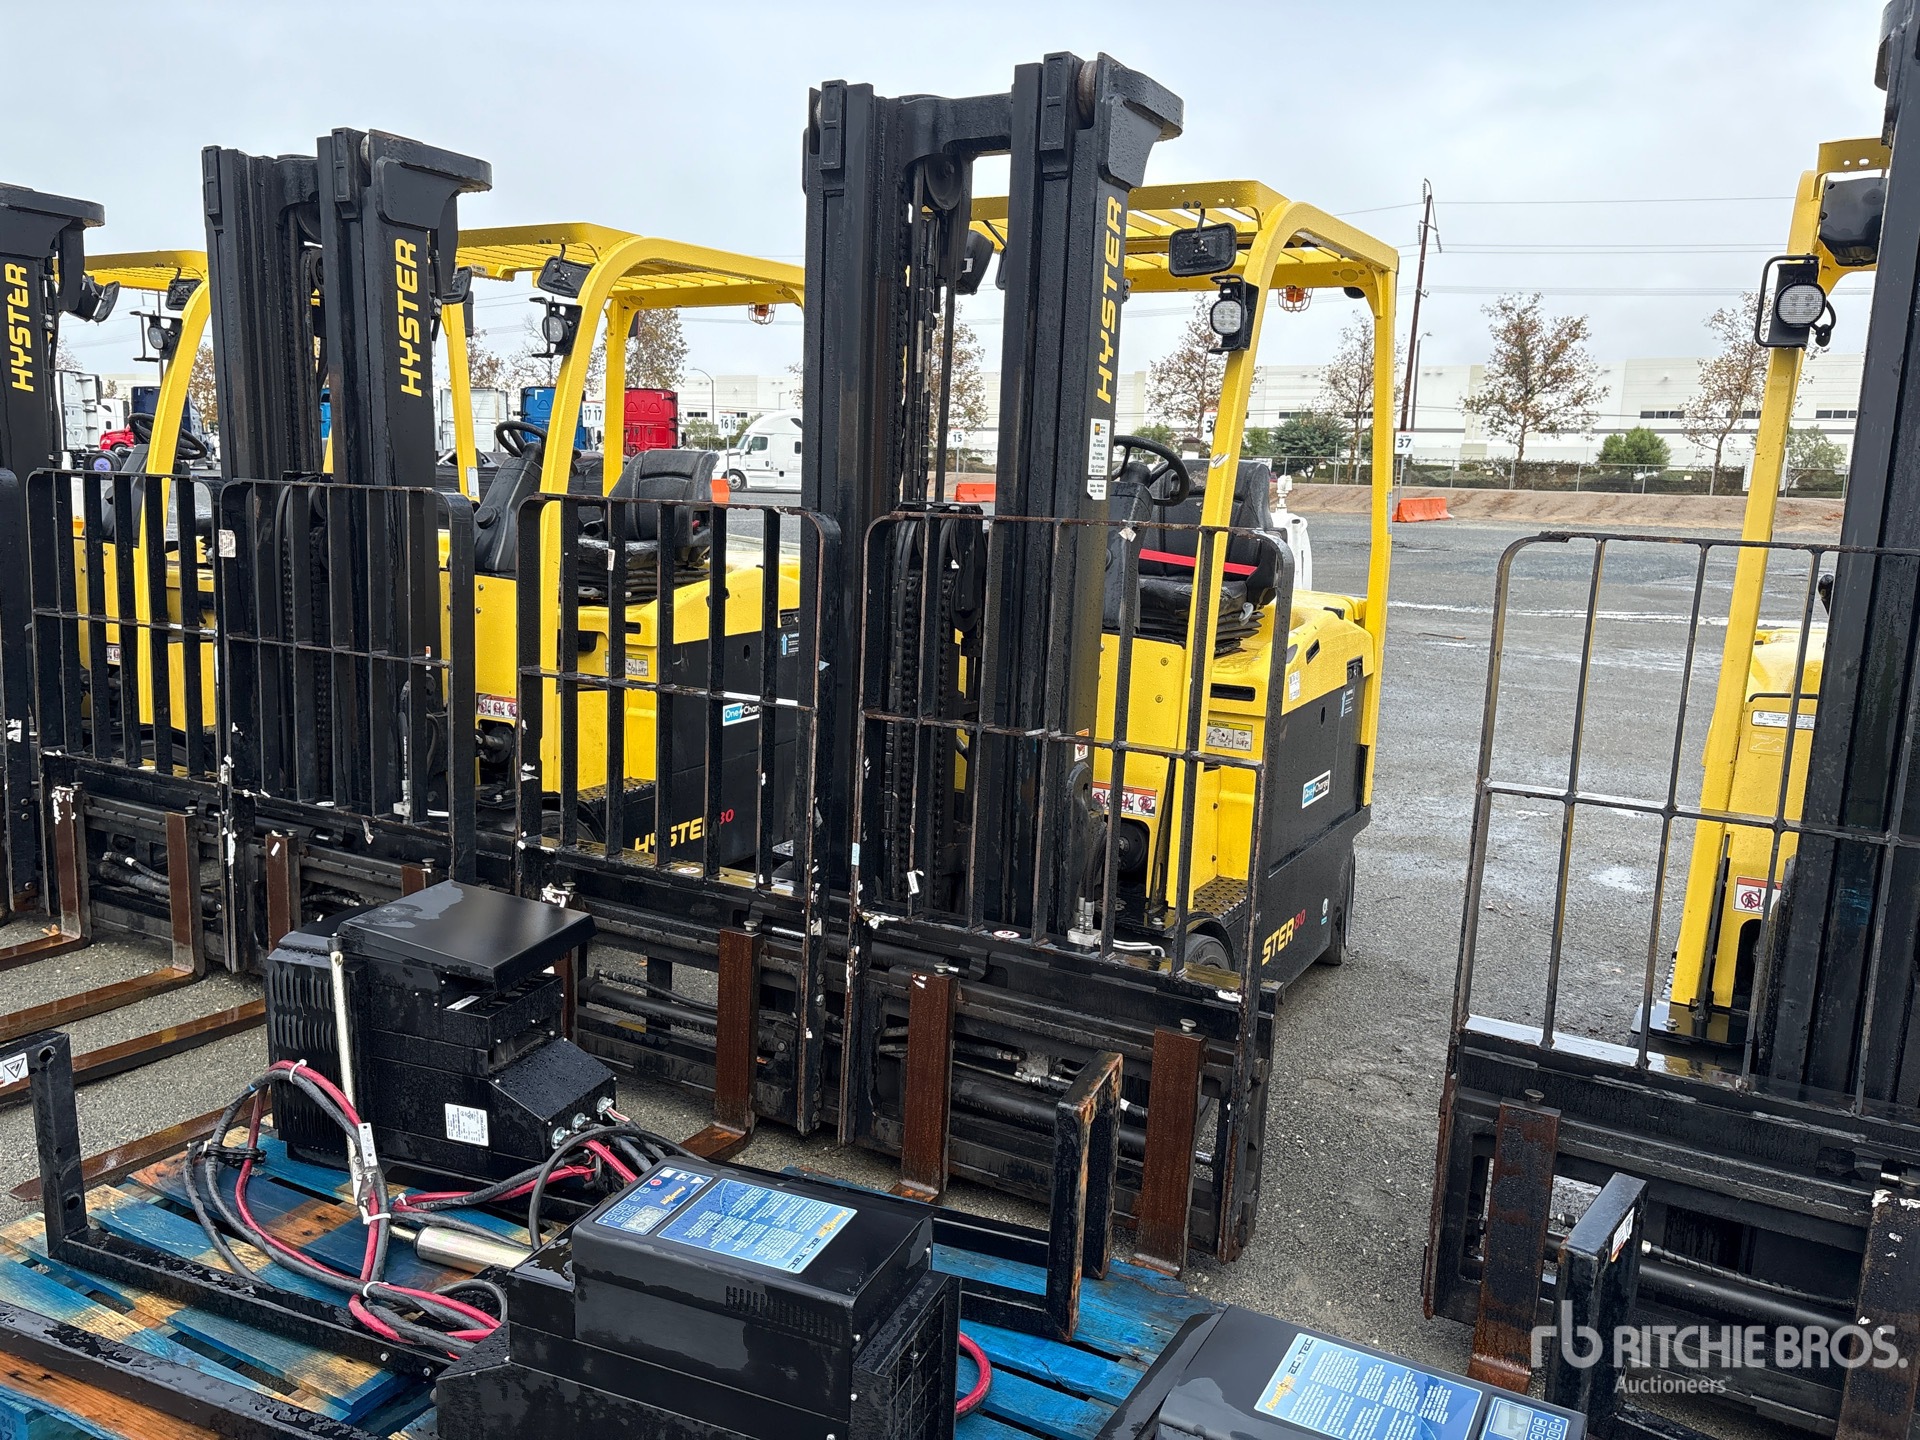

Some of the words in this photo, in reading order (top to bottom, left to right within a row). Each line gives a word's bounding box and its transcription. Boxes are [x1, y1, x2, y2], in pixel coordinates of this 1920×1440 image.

[1097, 196, 1122, 404] HYSTER
[4, 262, 35, 392] HYSTER
[395, 238, 422, 397] HYSTER
[584, 409, 592, 421] 17
[594, 409, 603, 421] 17
[720, 418, 729, 429] 16
[1205, 420, 1214, 433] 3
[953, 434, 963, 443] 15
[1397, 438, 1412, 448] 37
[1261, 917, 1295, 966] STER
[1287, 1337, 1314, 1375] ECOTEC
